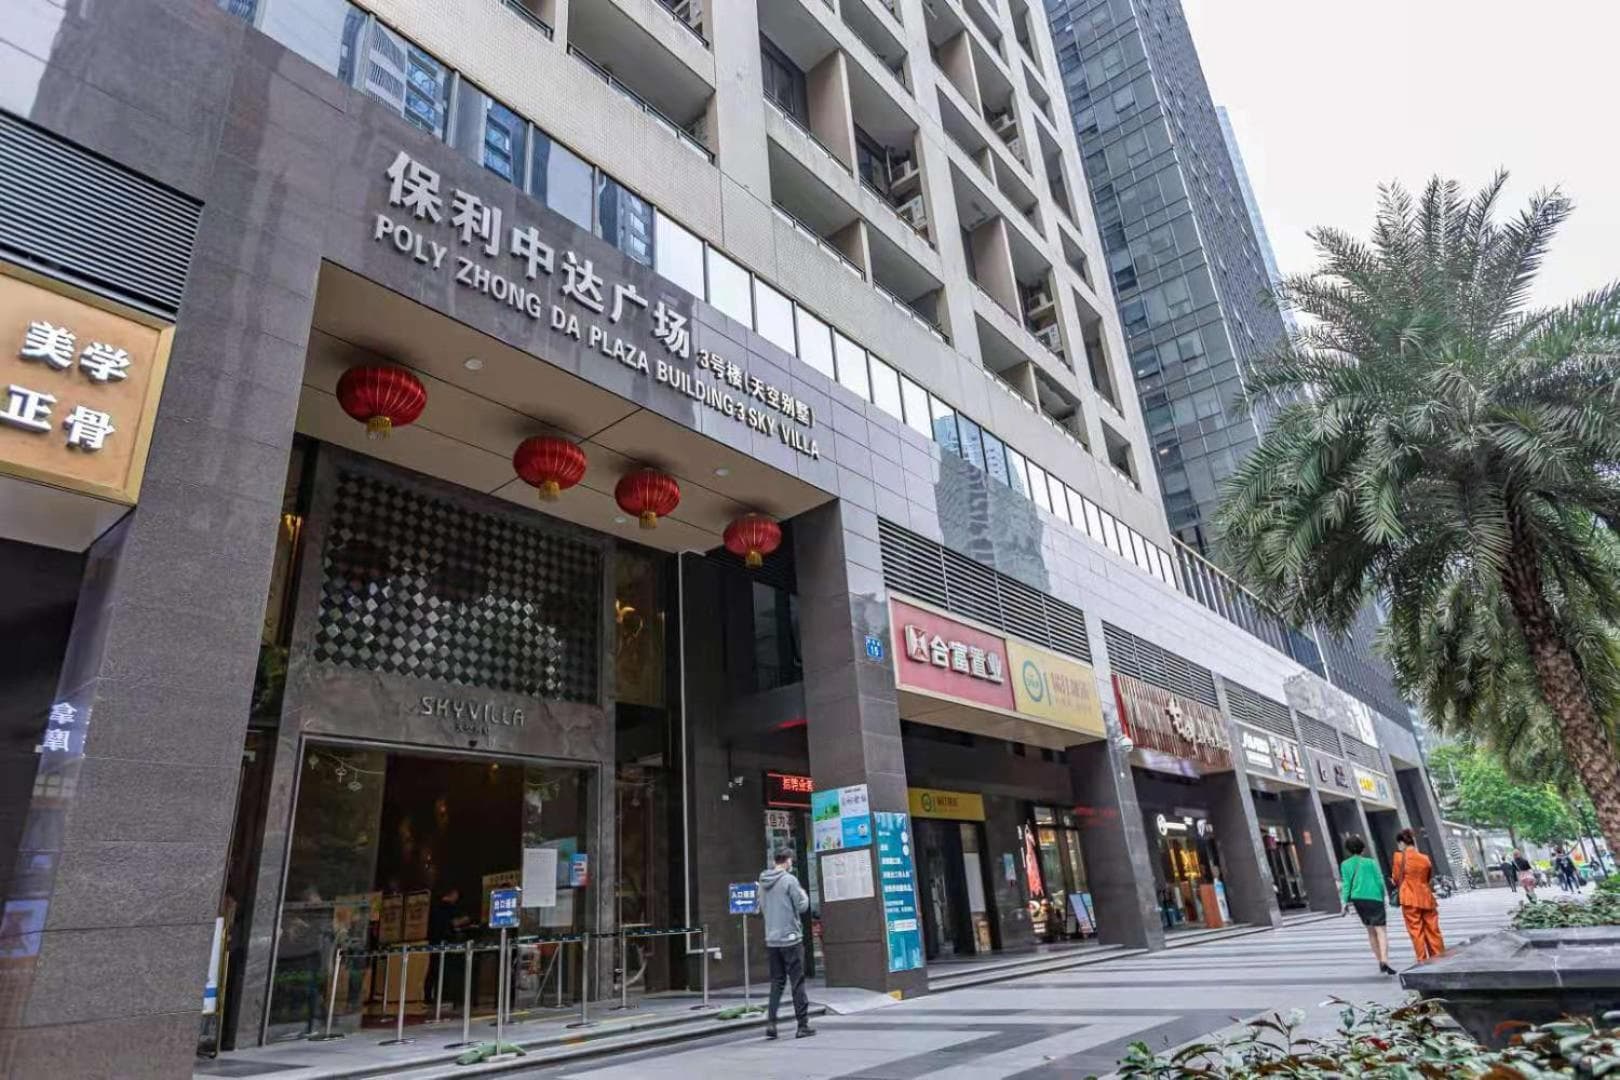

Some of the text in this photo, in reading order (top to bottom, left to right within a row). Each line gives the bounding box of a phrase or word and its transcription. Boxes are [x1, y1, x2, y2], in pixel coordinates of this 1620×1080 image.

[386, 150, 690, 359] 保利中达广场
[20, 320, 131, 383] 美学
[374, 213, 447, 270] POLY
[455, 256, 541, 319] ZHONG
[551, 304, 581, 340] DA
[588, 324, 650, 376] PLAZA
[656, 358, 733, 418] BUILDING
[747, 407, 775, 437] SKY
[778, 422, 820, 460] VILLA
[0, 384, 117, 452] 正骨
[929, 633, 1005, 685] 合富置业
